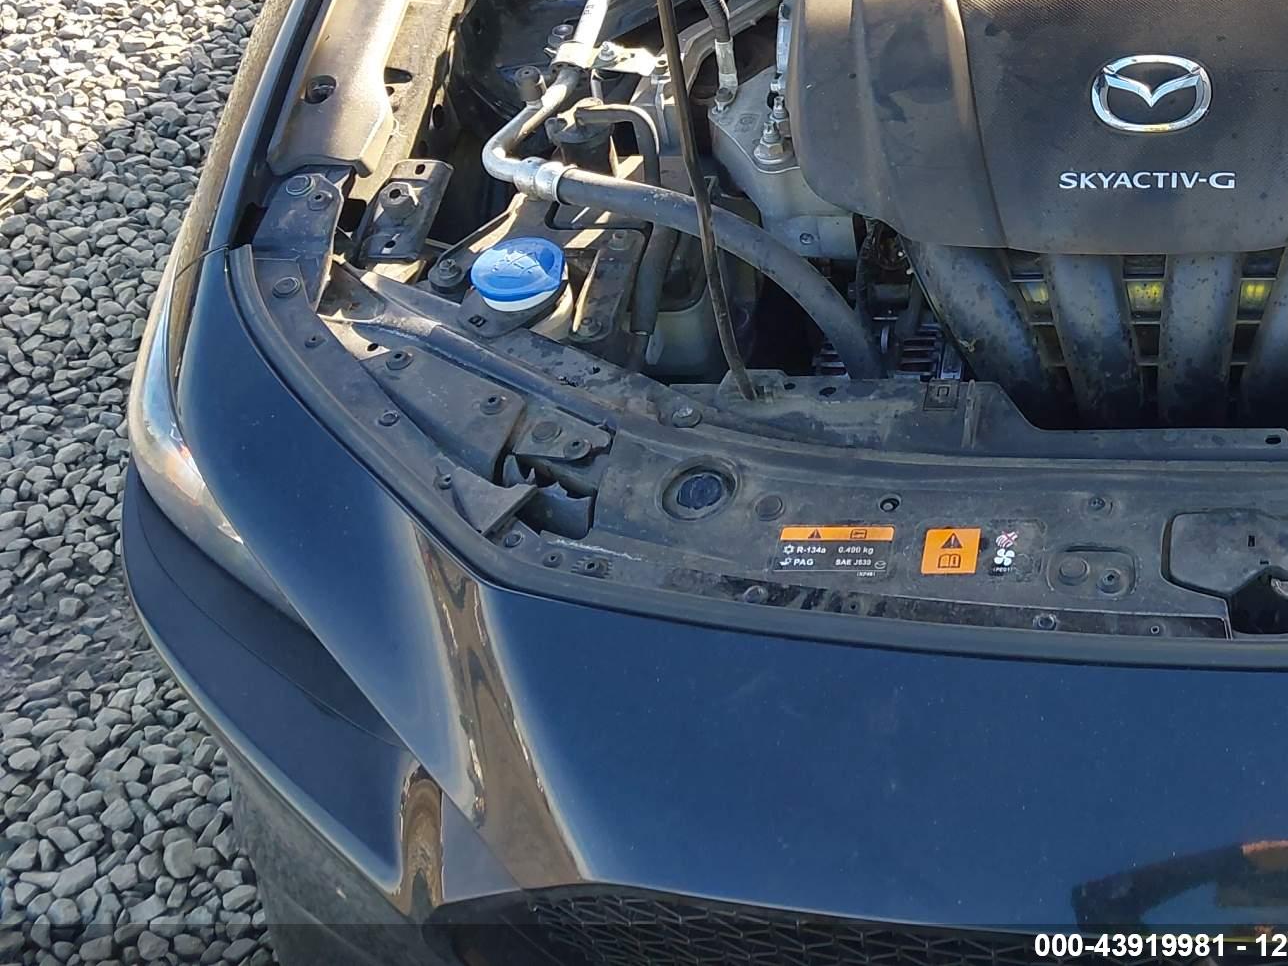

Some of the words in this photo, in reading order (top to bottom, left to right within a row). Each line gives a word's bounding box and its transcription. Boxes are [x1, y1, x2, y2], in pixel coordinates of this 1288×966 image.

[1058, 171, 1236, 190] SKYACTIV-G
[796, 545, 827, 554] R-134a
[863, 546, 874, 556] kg
[793, 558, 814, 566] PAG
[835, 558, 852, 566] SAE
